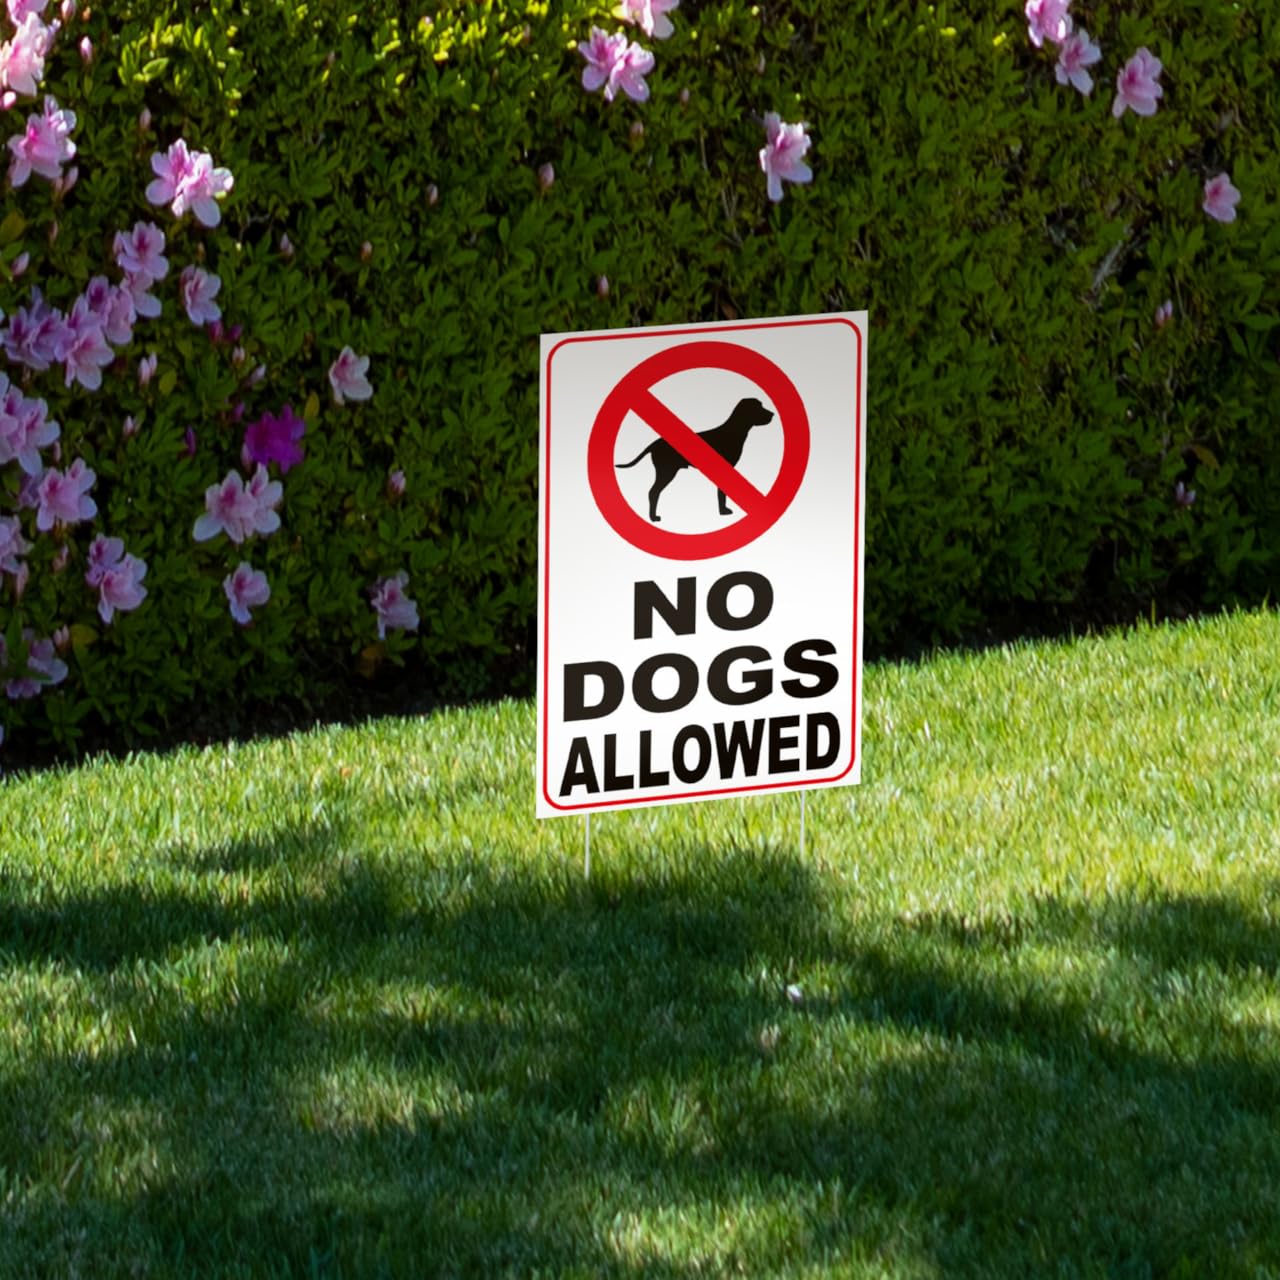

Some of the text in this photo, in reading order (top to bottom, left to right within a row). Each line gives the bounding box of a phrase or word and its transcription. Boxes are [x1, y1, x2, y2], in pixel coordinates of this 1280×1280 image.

[633, 571, 774, 640] NO
[563, 638, 839, 722] DOGS
[559, 711, 841, 797] ALLOWED
